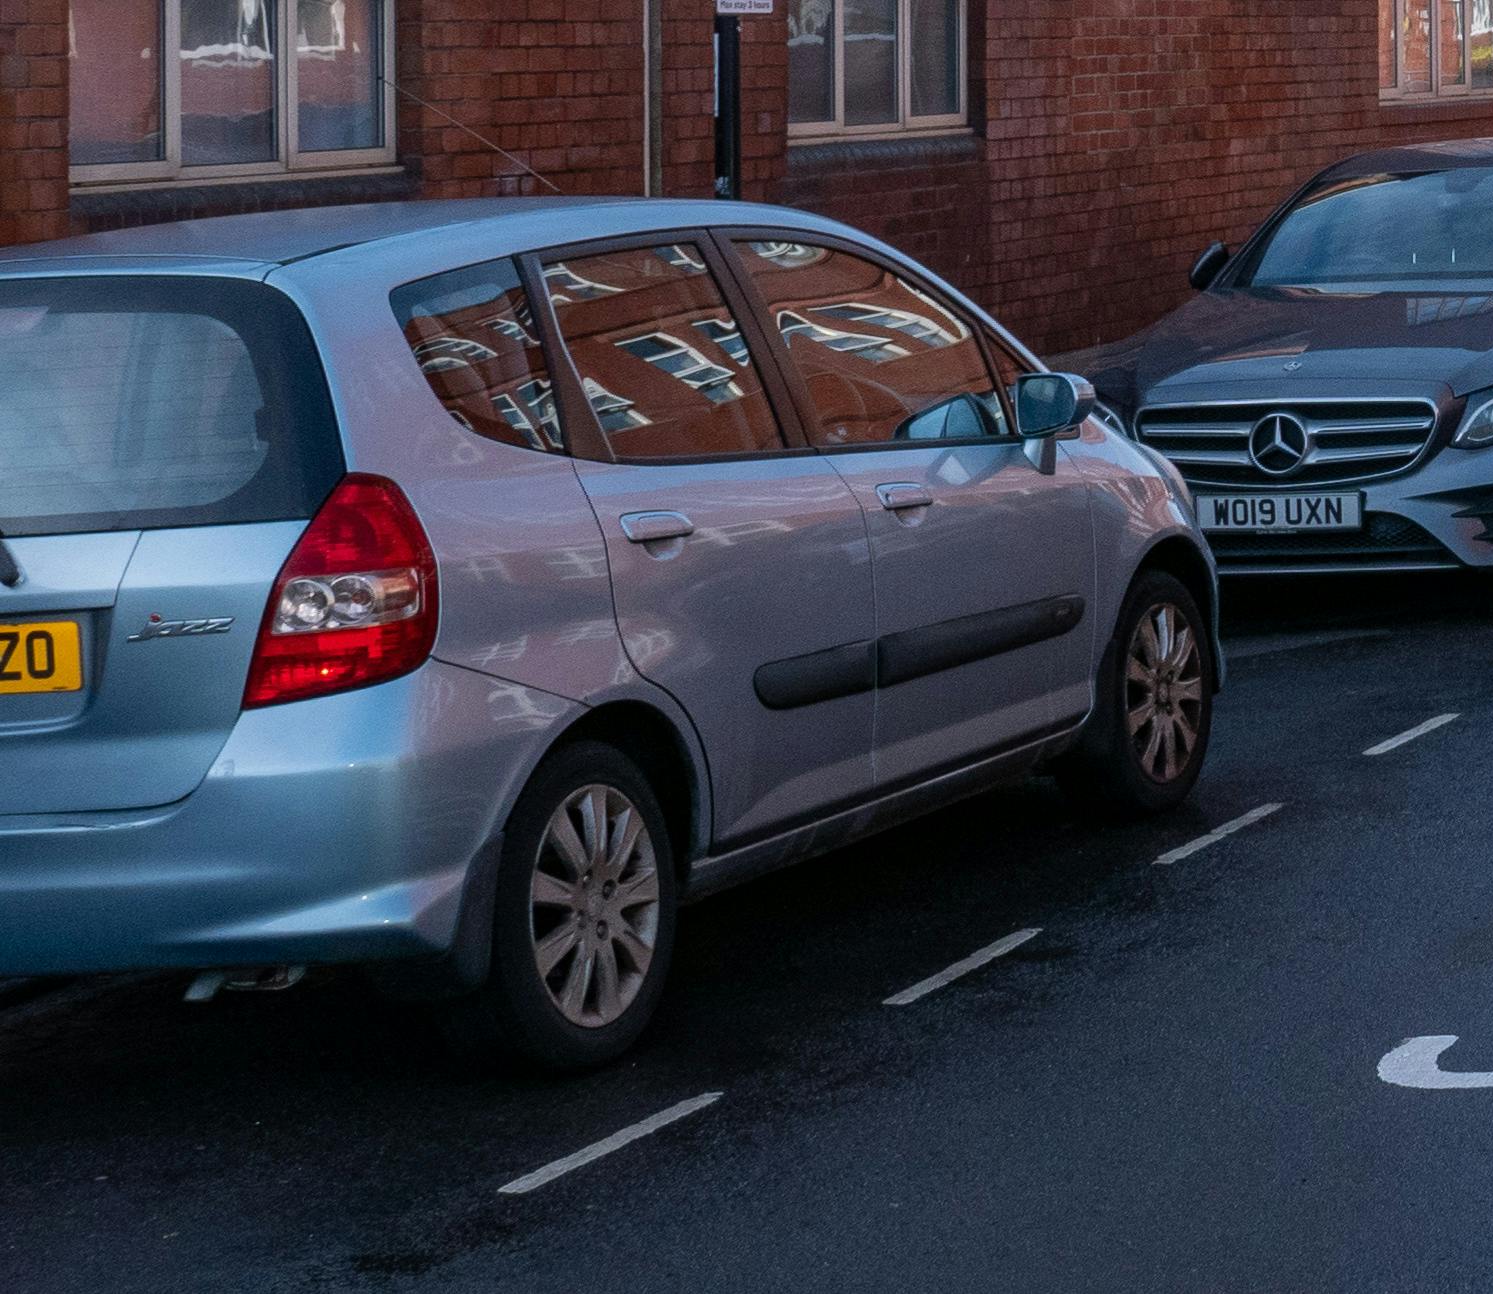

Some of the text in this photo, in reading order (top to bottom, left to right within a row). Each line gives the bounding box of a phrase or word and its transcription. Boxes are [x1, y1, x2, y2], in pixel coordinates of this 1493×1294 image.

[1213, 497, 1343, 526] WO19 UXN
[0, 630, 56, 681] ZO
